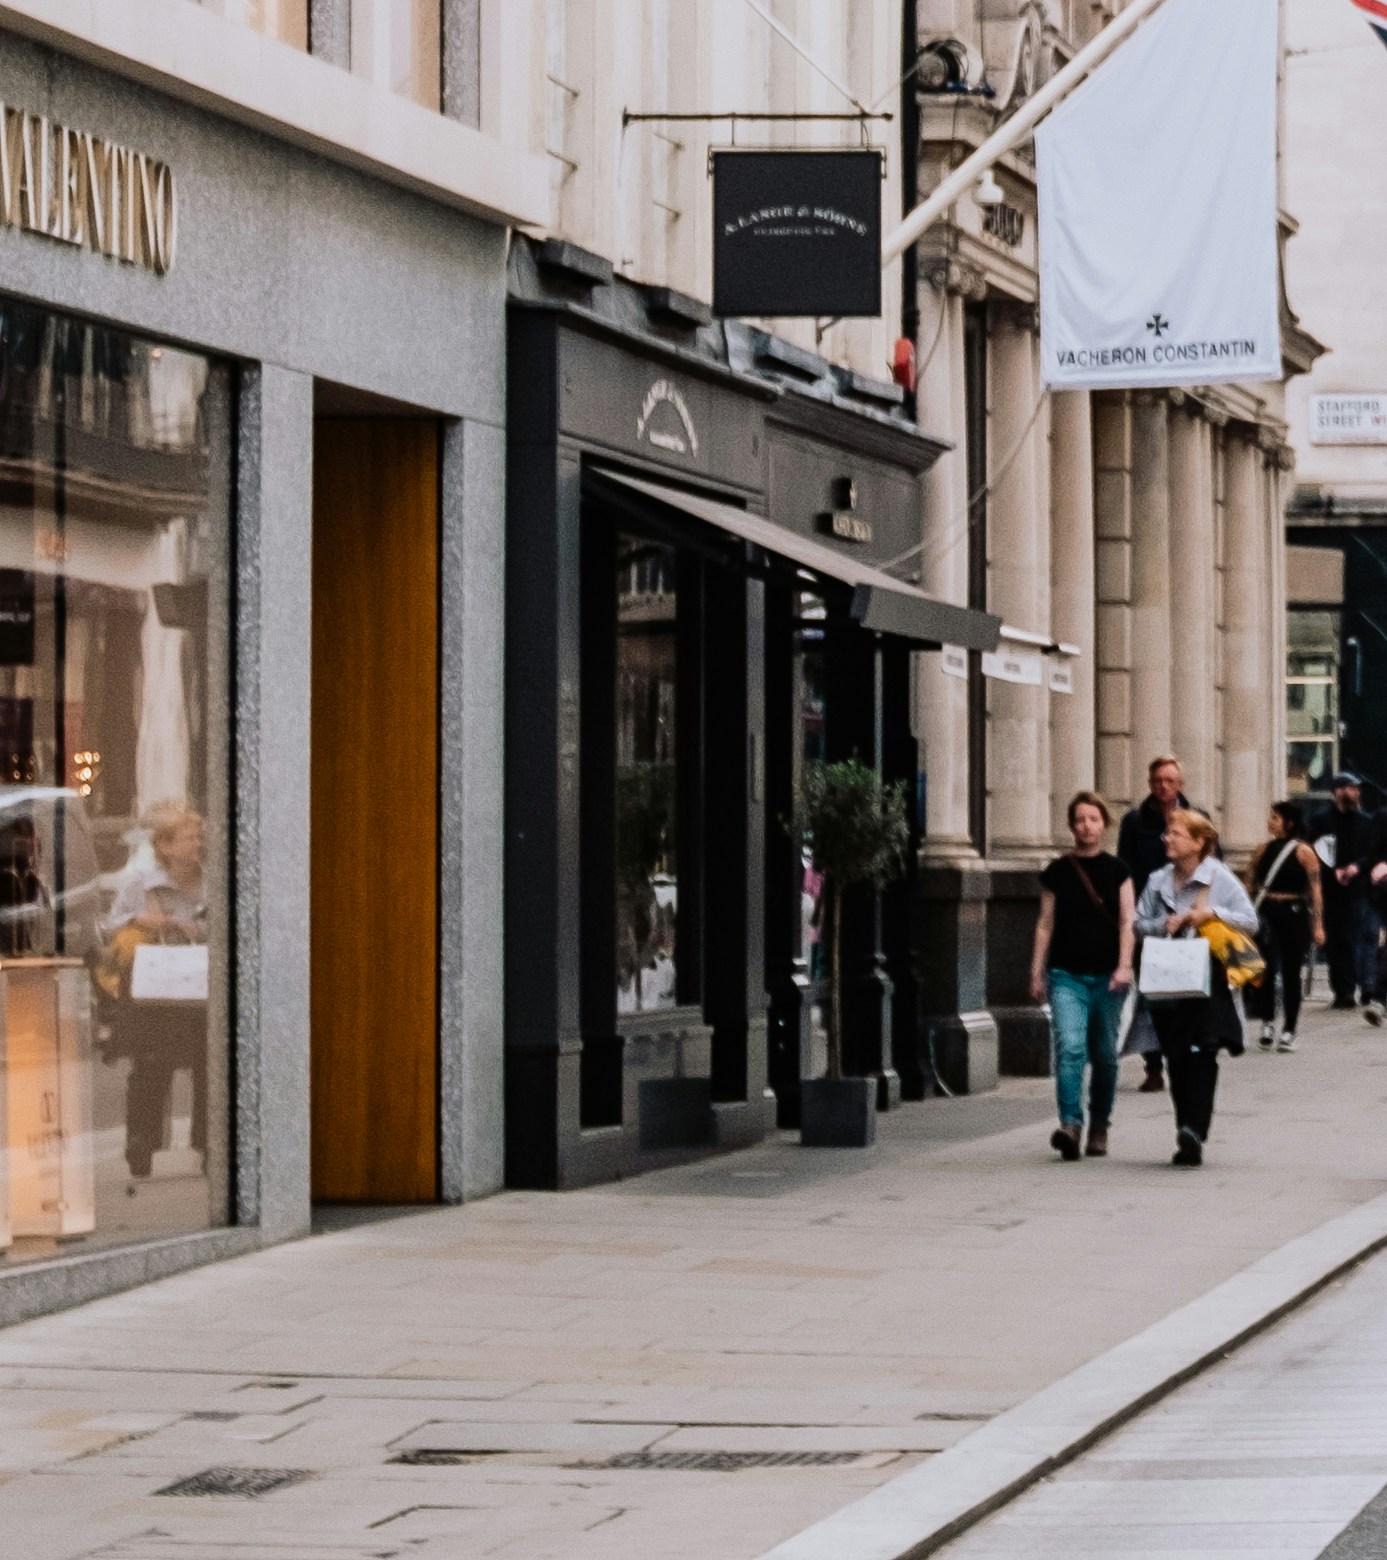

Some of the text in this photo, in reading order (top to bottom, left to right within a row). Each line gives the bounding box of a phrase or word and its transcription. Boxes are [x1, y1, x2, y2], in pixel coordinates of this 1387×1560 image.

[0, 101, 178, 276] VALENTINO
[1057, 340, 1255, 367] VACHERON CONSTANTIN
[1317, 415, 1361, 428] STREET
